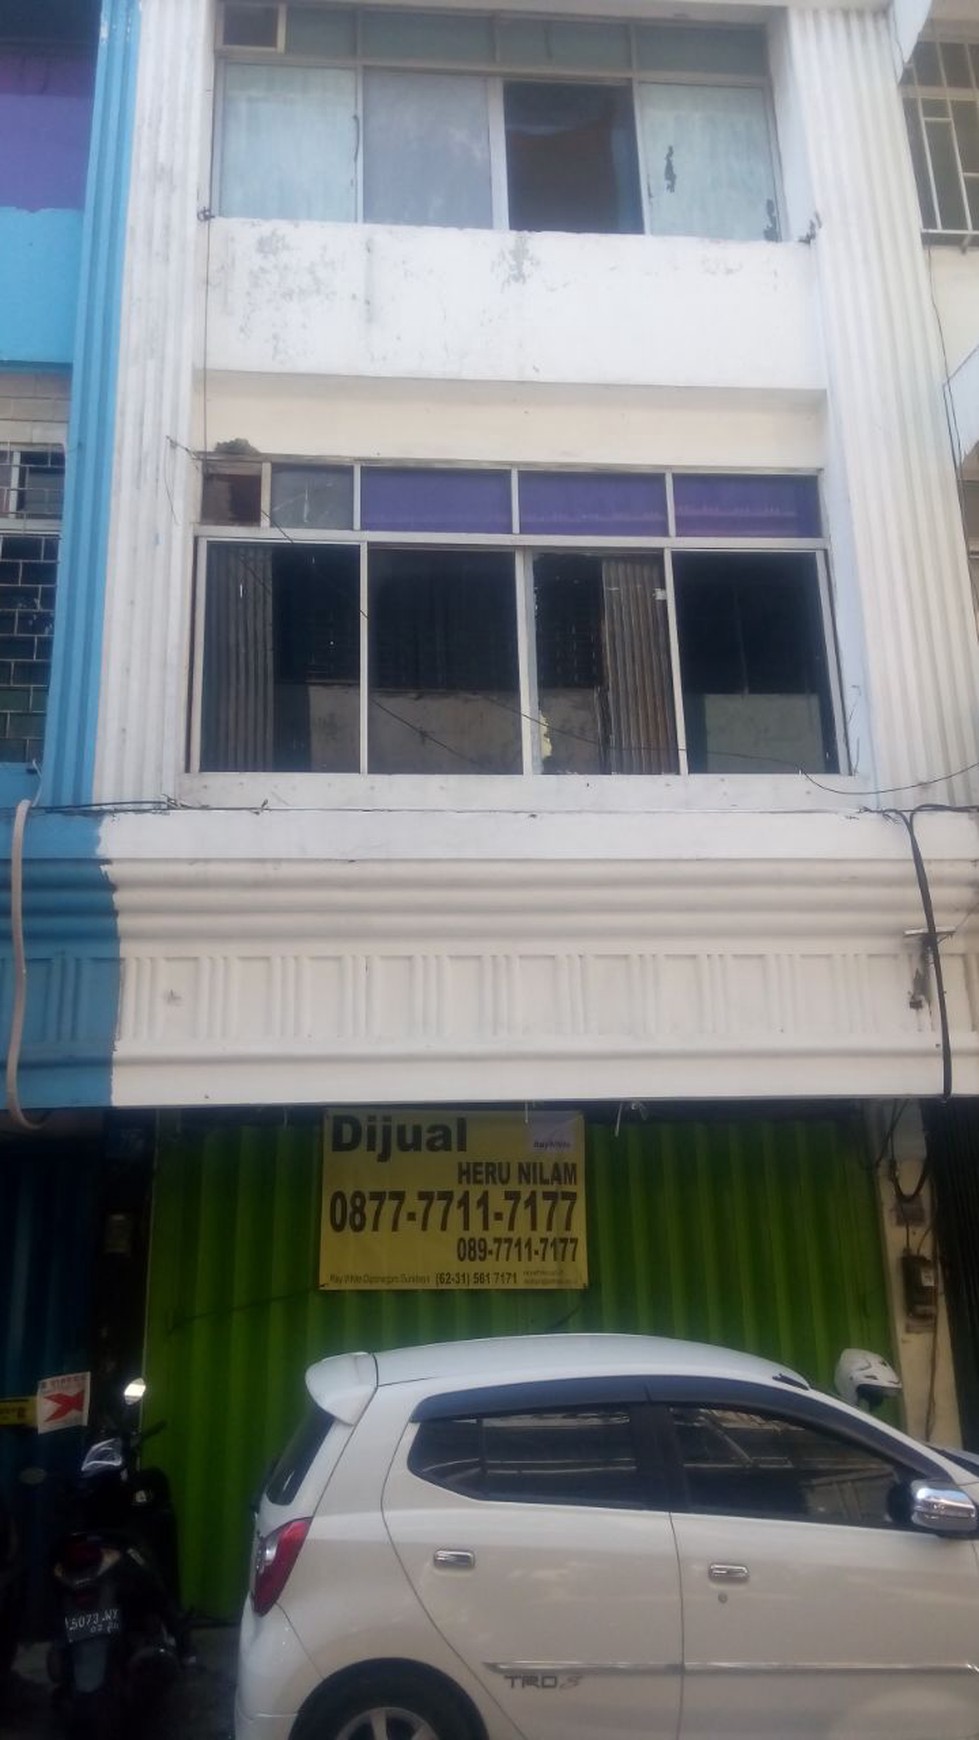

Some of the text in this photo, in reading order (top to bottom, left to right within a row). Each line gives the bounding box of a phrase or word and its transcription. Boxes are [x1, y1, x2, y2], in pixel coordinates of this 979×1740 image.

[331, 1115, 467, 1162] Dijual
[457, 1162, 577, 1185] HERU NILAM
[329, 1191, 577, 1232] 0877-7711-7177
[457, 1237, 578, 1262] 089-7711-7177
[493, 1272, 517, 1284] 7171
[503, 1675, 557, 1689] TRD
